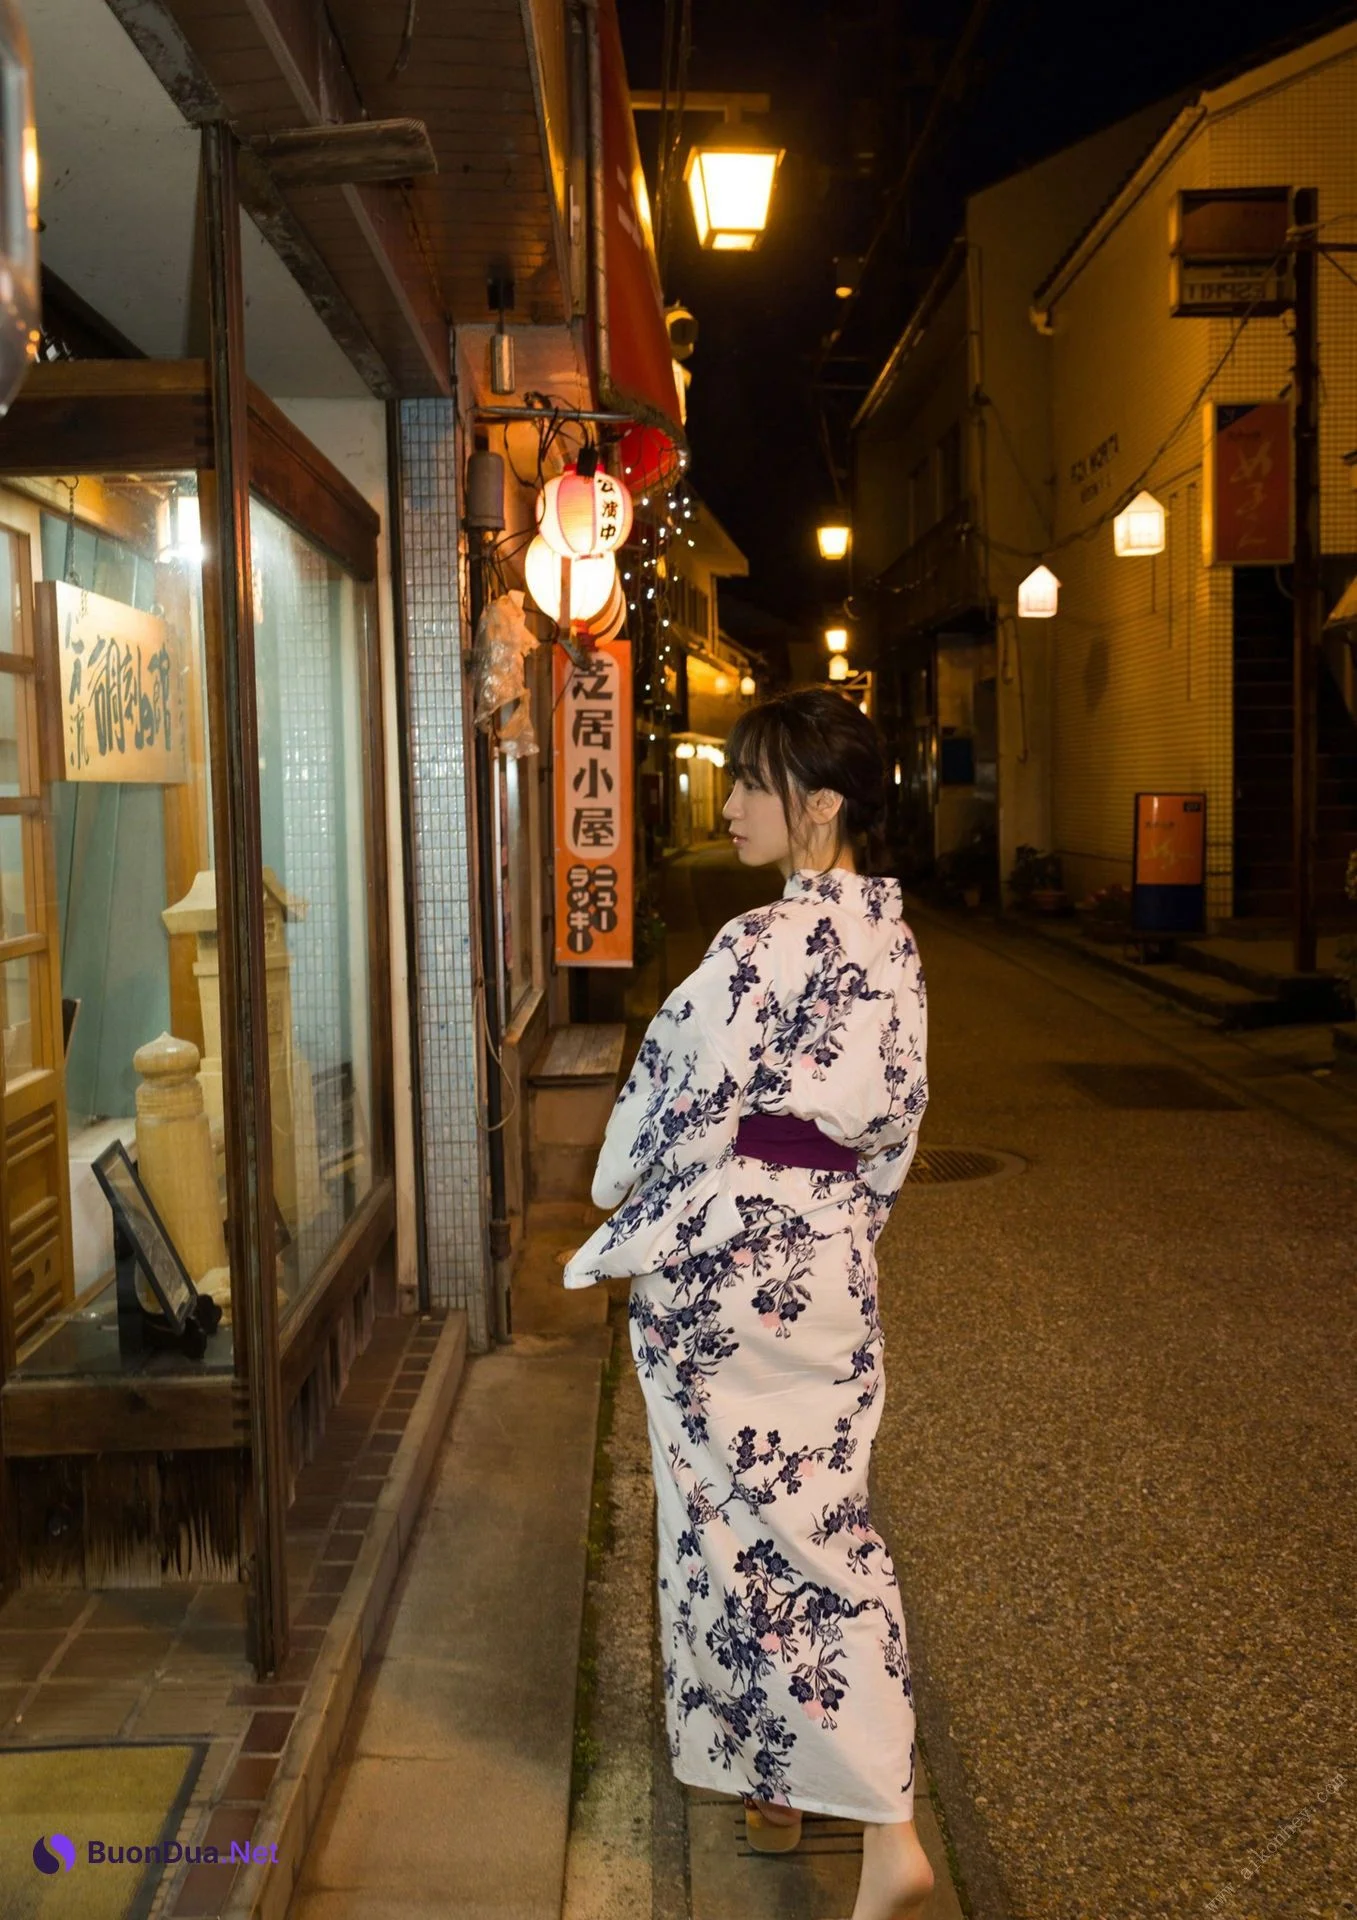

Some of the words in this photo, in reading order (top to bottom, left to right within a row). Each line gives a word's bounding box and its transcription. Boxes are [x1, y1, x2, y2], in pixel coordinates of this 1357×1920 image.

[597, 478, 619, 541] 公演中
[572, 658, 614, 849] 芝居小屋
[569, 868, 591, 952] ラッキー
[595, 868, 614, 930] ニュー
